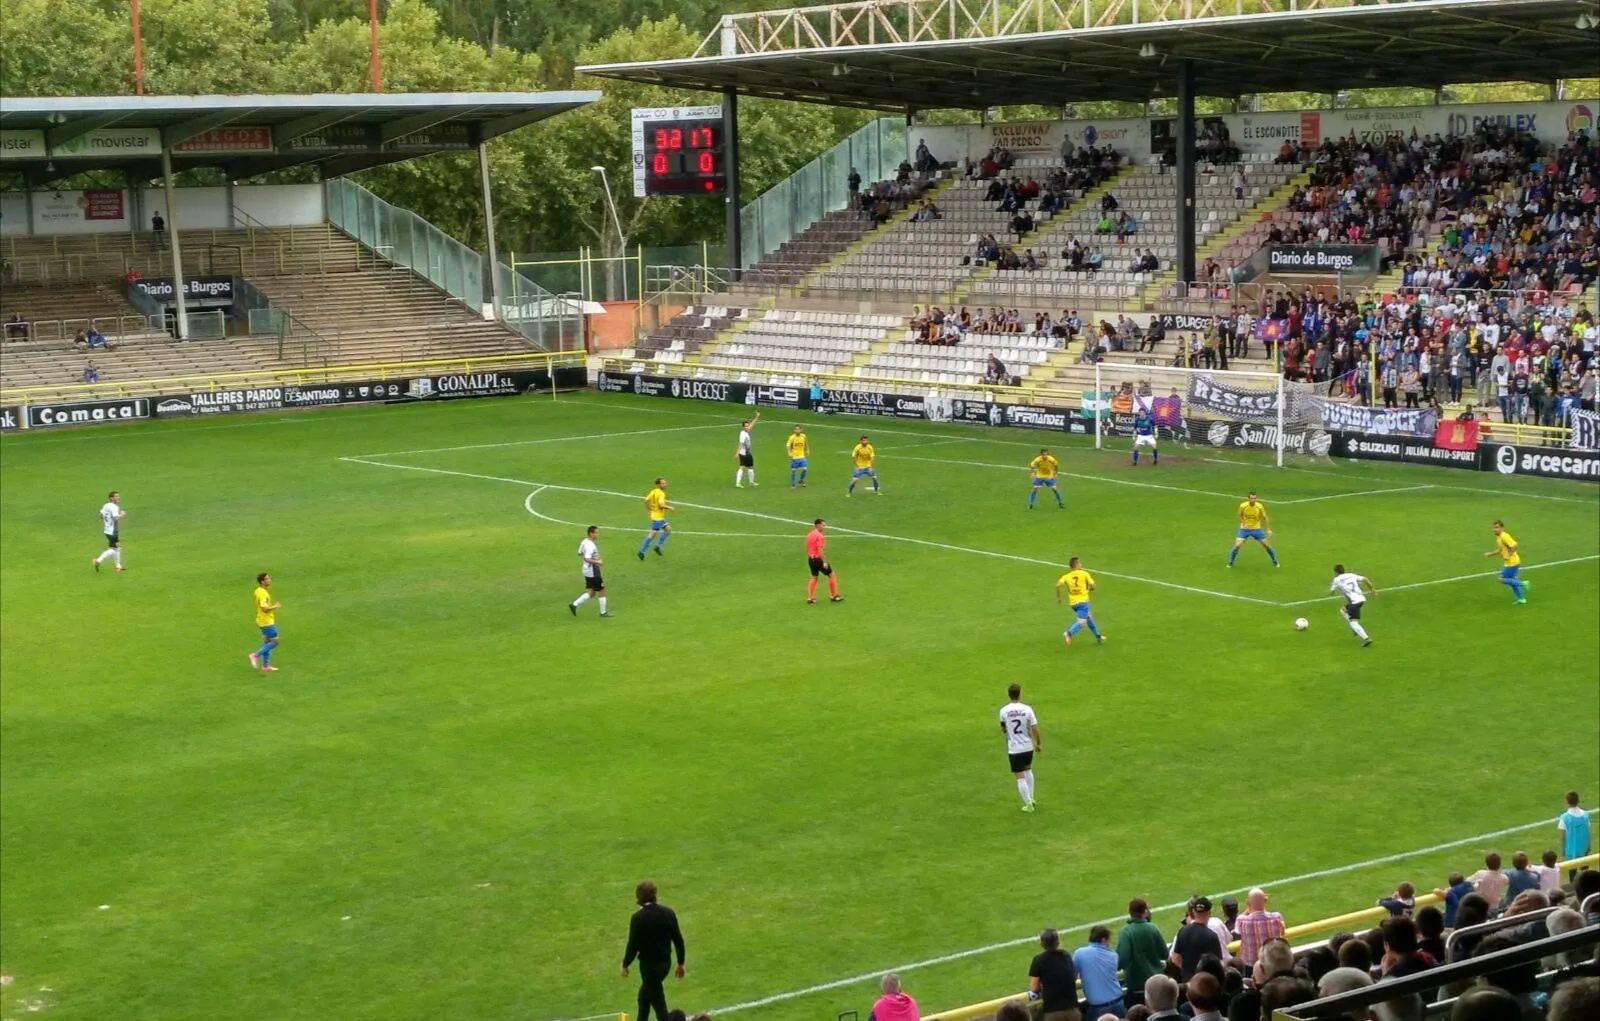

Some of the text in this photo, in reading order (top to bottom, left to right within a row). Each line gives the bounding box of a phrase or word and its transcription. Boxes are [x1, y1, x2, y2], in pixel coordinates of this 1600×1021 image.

[690, 127, 713, 148] 17
[1243, 126, 1299, 139] EL ESCONDITE
[91, 136, 149, 148] movistar
[653, 153, 668, 175] 0
[699, 152, 714, 173] 0
[1271, 250, 1353, 269] Diario de Burgos
[191, 281, 231, 295] Burgos
[438, 373, 498, 391] GONALPI
[191, 391, 244, 407] TALLERES
[246, 388, 281, 402] PARDO
[821, 390, 849, 402] CASA
[896, 399, 924, 411] Canon
[40, 400, 141, 424] Comacal
[1359, 442, 1475, 461] SUZUKI JULIÁN AUTO-SPORT
[1011, 719, 1023, 735] 2
